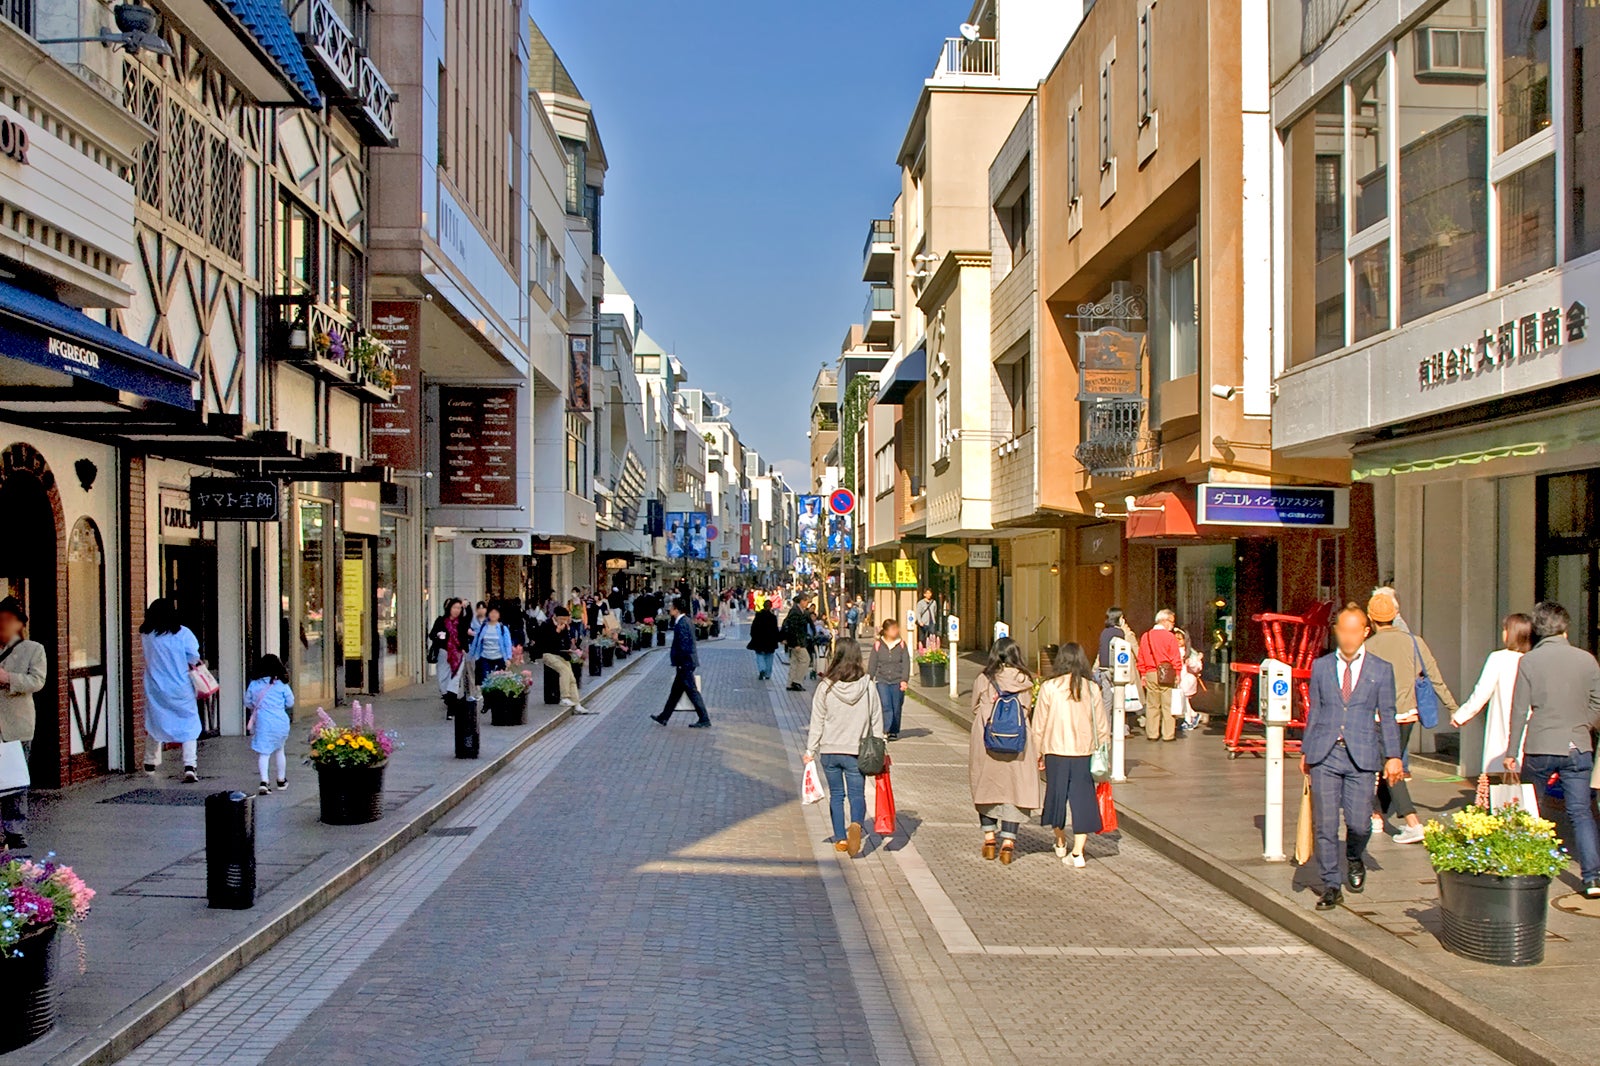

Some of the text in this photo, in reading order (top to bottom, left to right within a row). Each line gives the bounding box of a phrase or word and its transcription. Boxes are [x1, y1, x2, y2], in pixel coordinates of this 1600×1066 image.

[198, 492, 273, 508] ヤマト宝飾
[1213, 491, 1325, 507] ダニエル インテリアスタジオ
